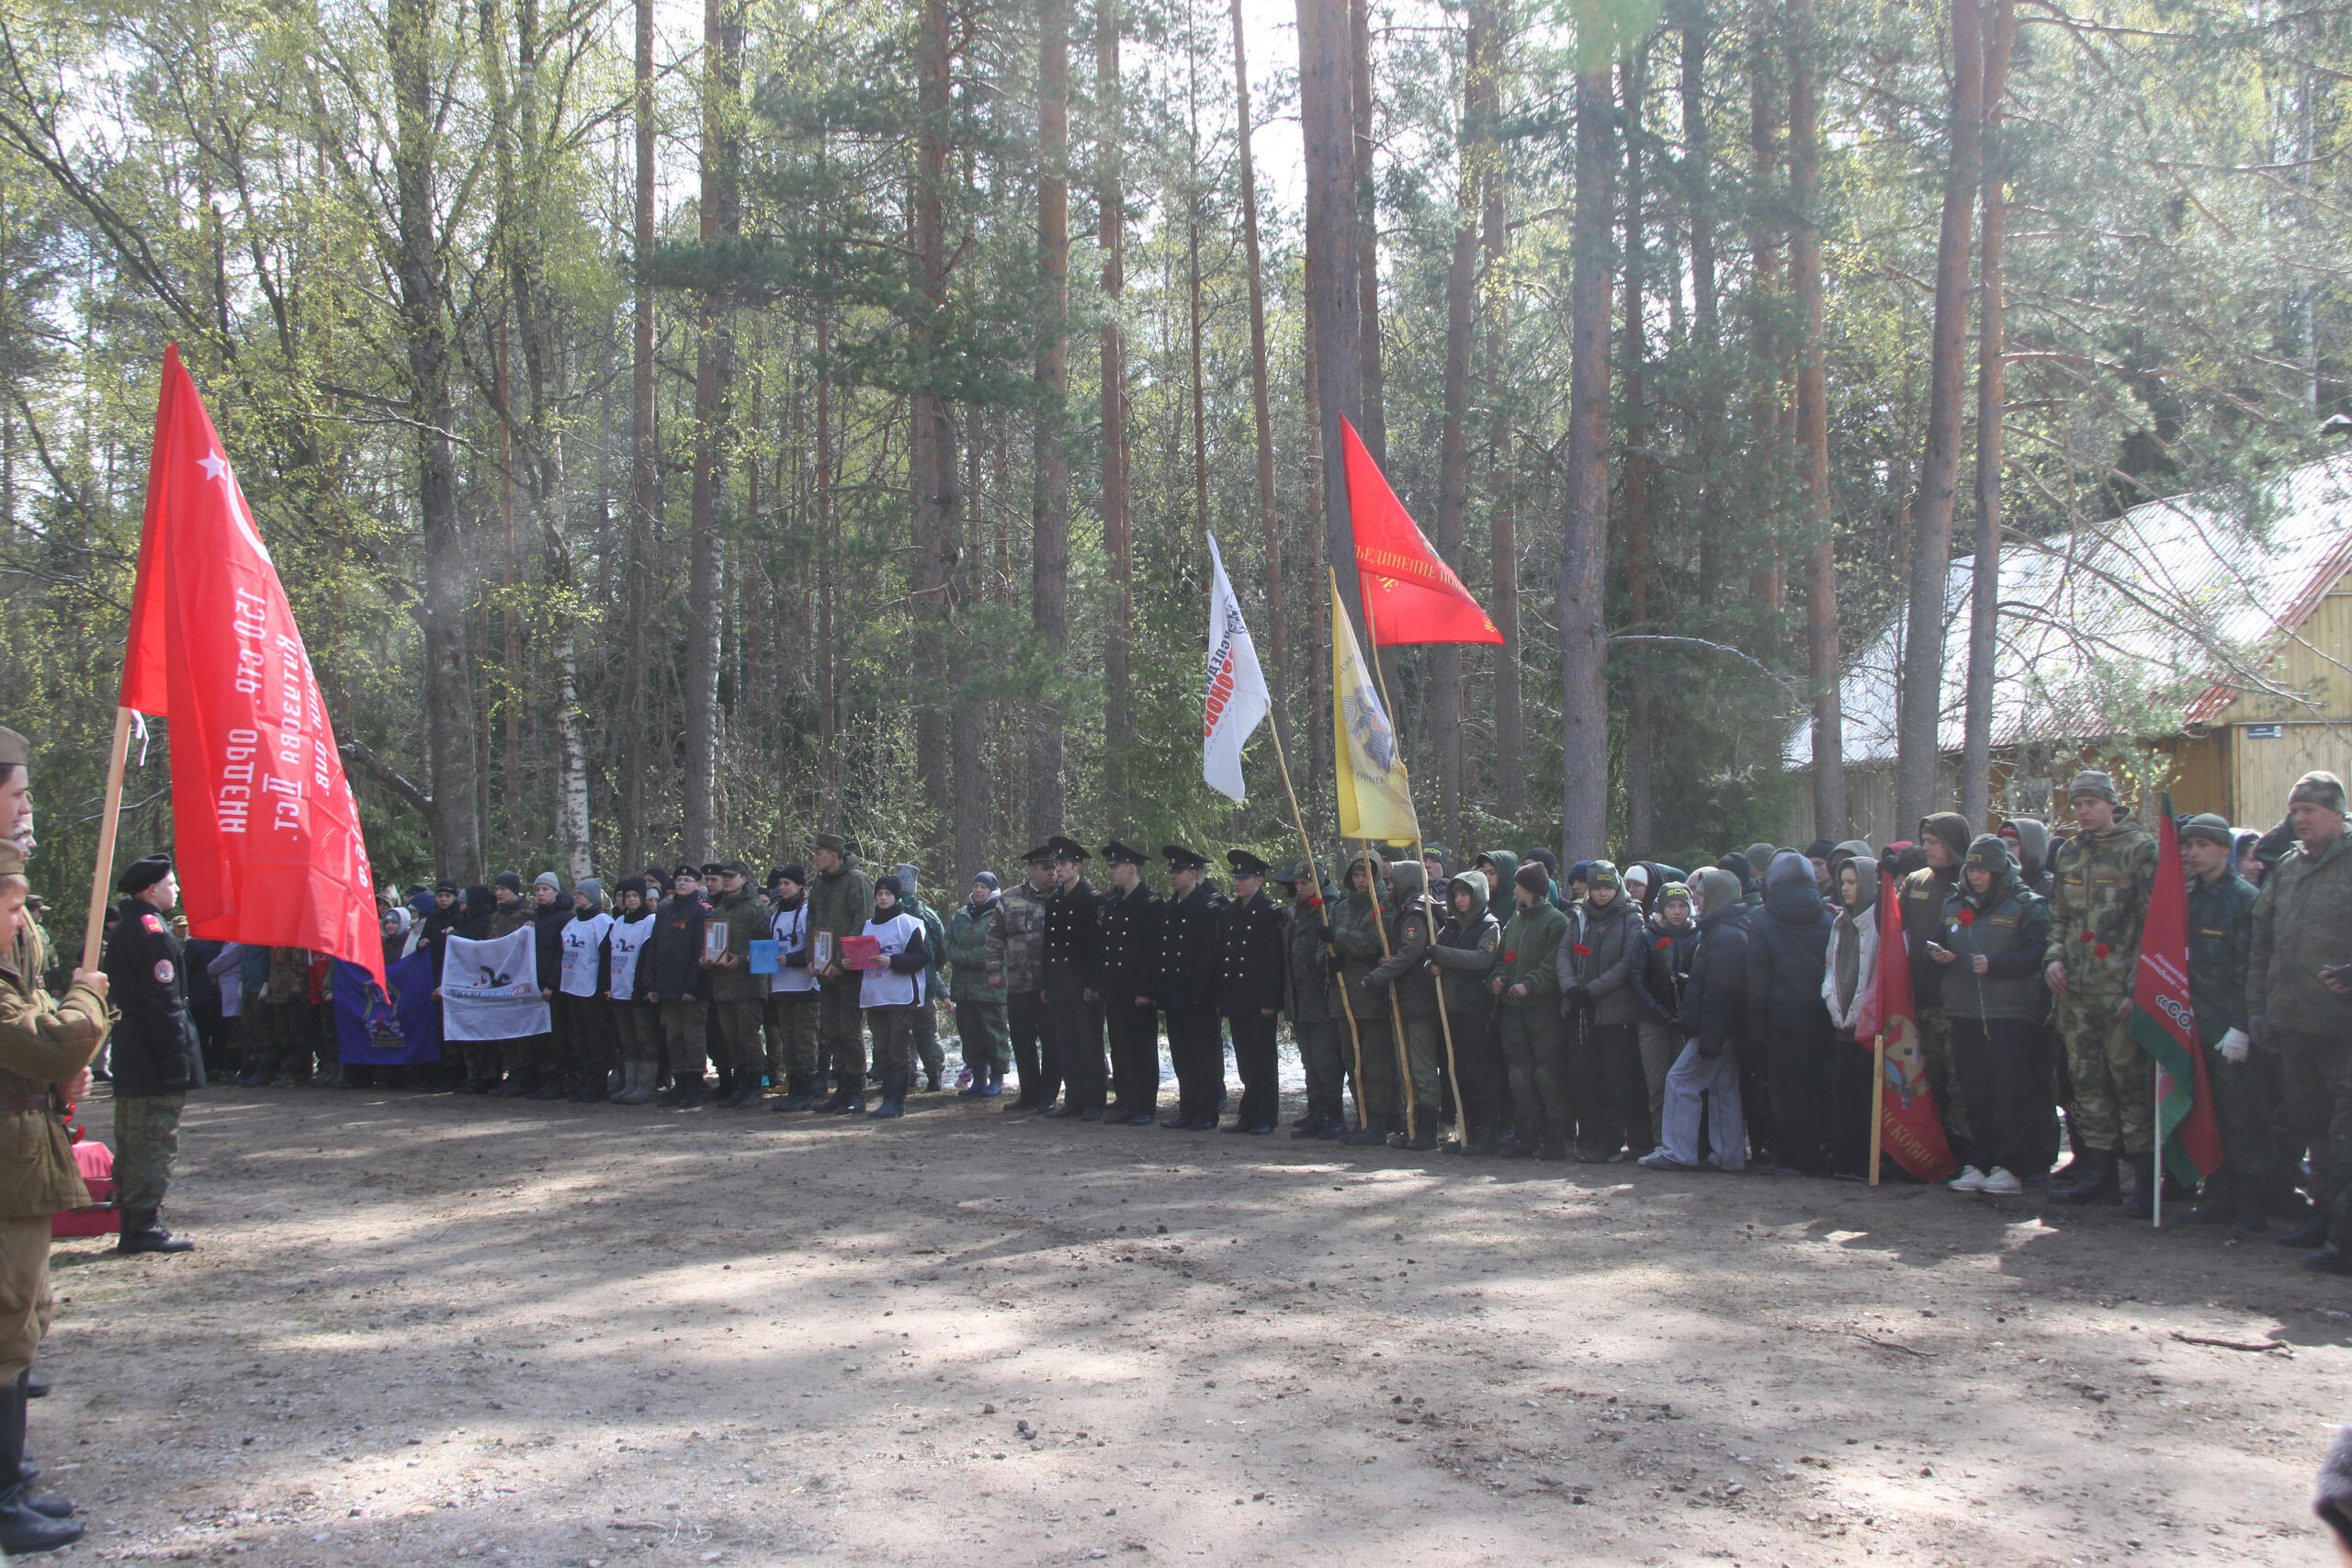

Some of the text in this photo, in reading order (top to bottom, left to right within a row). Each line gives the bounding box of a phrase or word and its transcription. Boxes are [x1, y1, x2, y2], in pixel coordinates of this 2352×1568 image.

[1355, 545, 1438, 581] ЪЕДИНЕНИЕ
[2154, 994, 2194, 1031] «СО
[1882, 1106, 1938, 1170] ИСКОВИК
